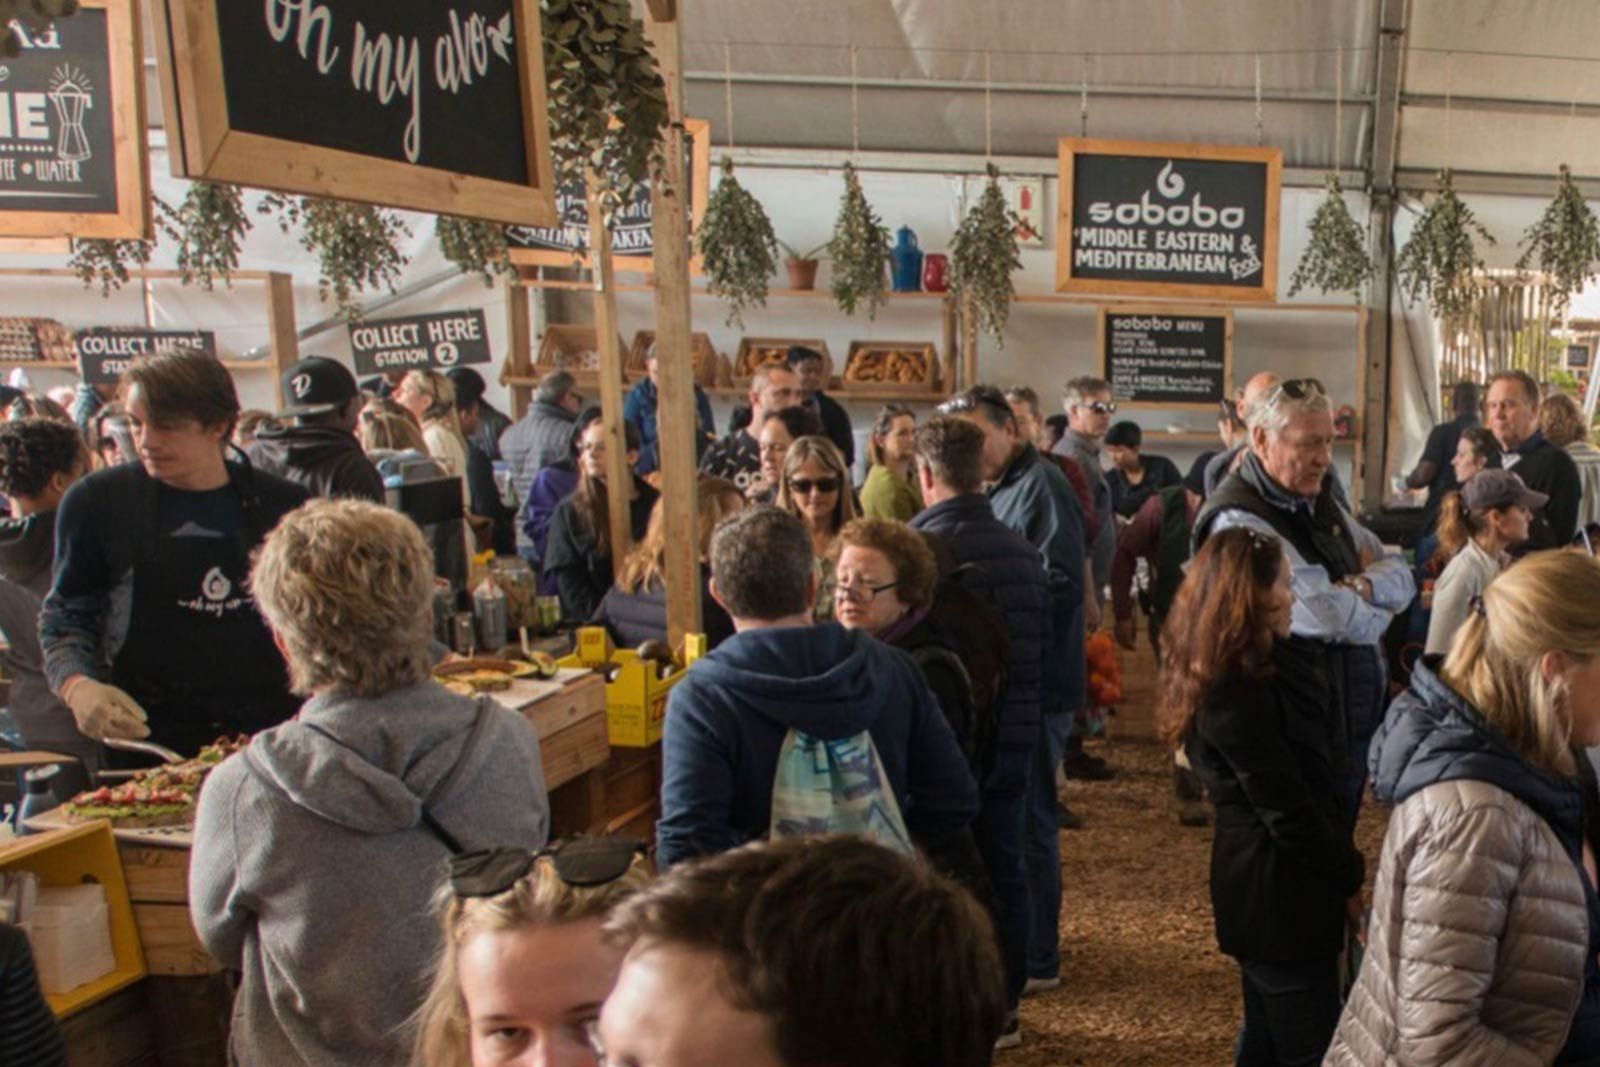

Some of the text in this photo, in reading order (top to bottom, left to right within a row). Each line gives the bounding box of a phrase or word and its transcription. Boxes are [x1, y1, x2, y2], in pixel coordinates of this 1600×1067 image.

[351, 21, 421, 163] my
[34, 158, 82, 183] WATER
[1080, 228, 1257, 256] MIDDLE EASTERN &
[1075, 249, 1226, 273] MEDITERRANEAN
[81, 335, 148, 355] COLLECT
[352, 317, 481, 351] COLLECT HERE
[373, 347, 429, 368] STATION
